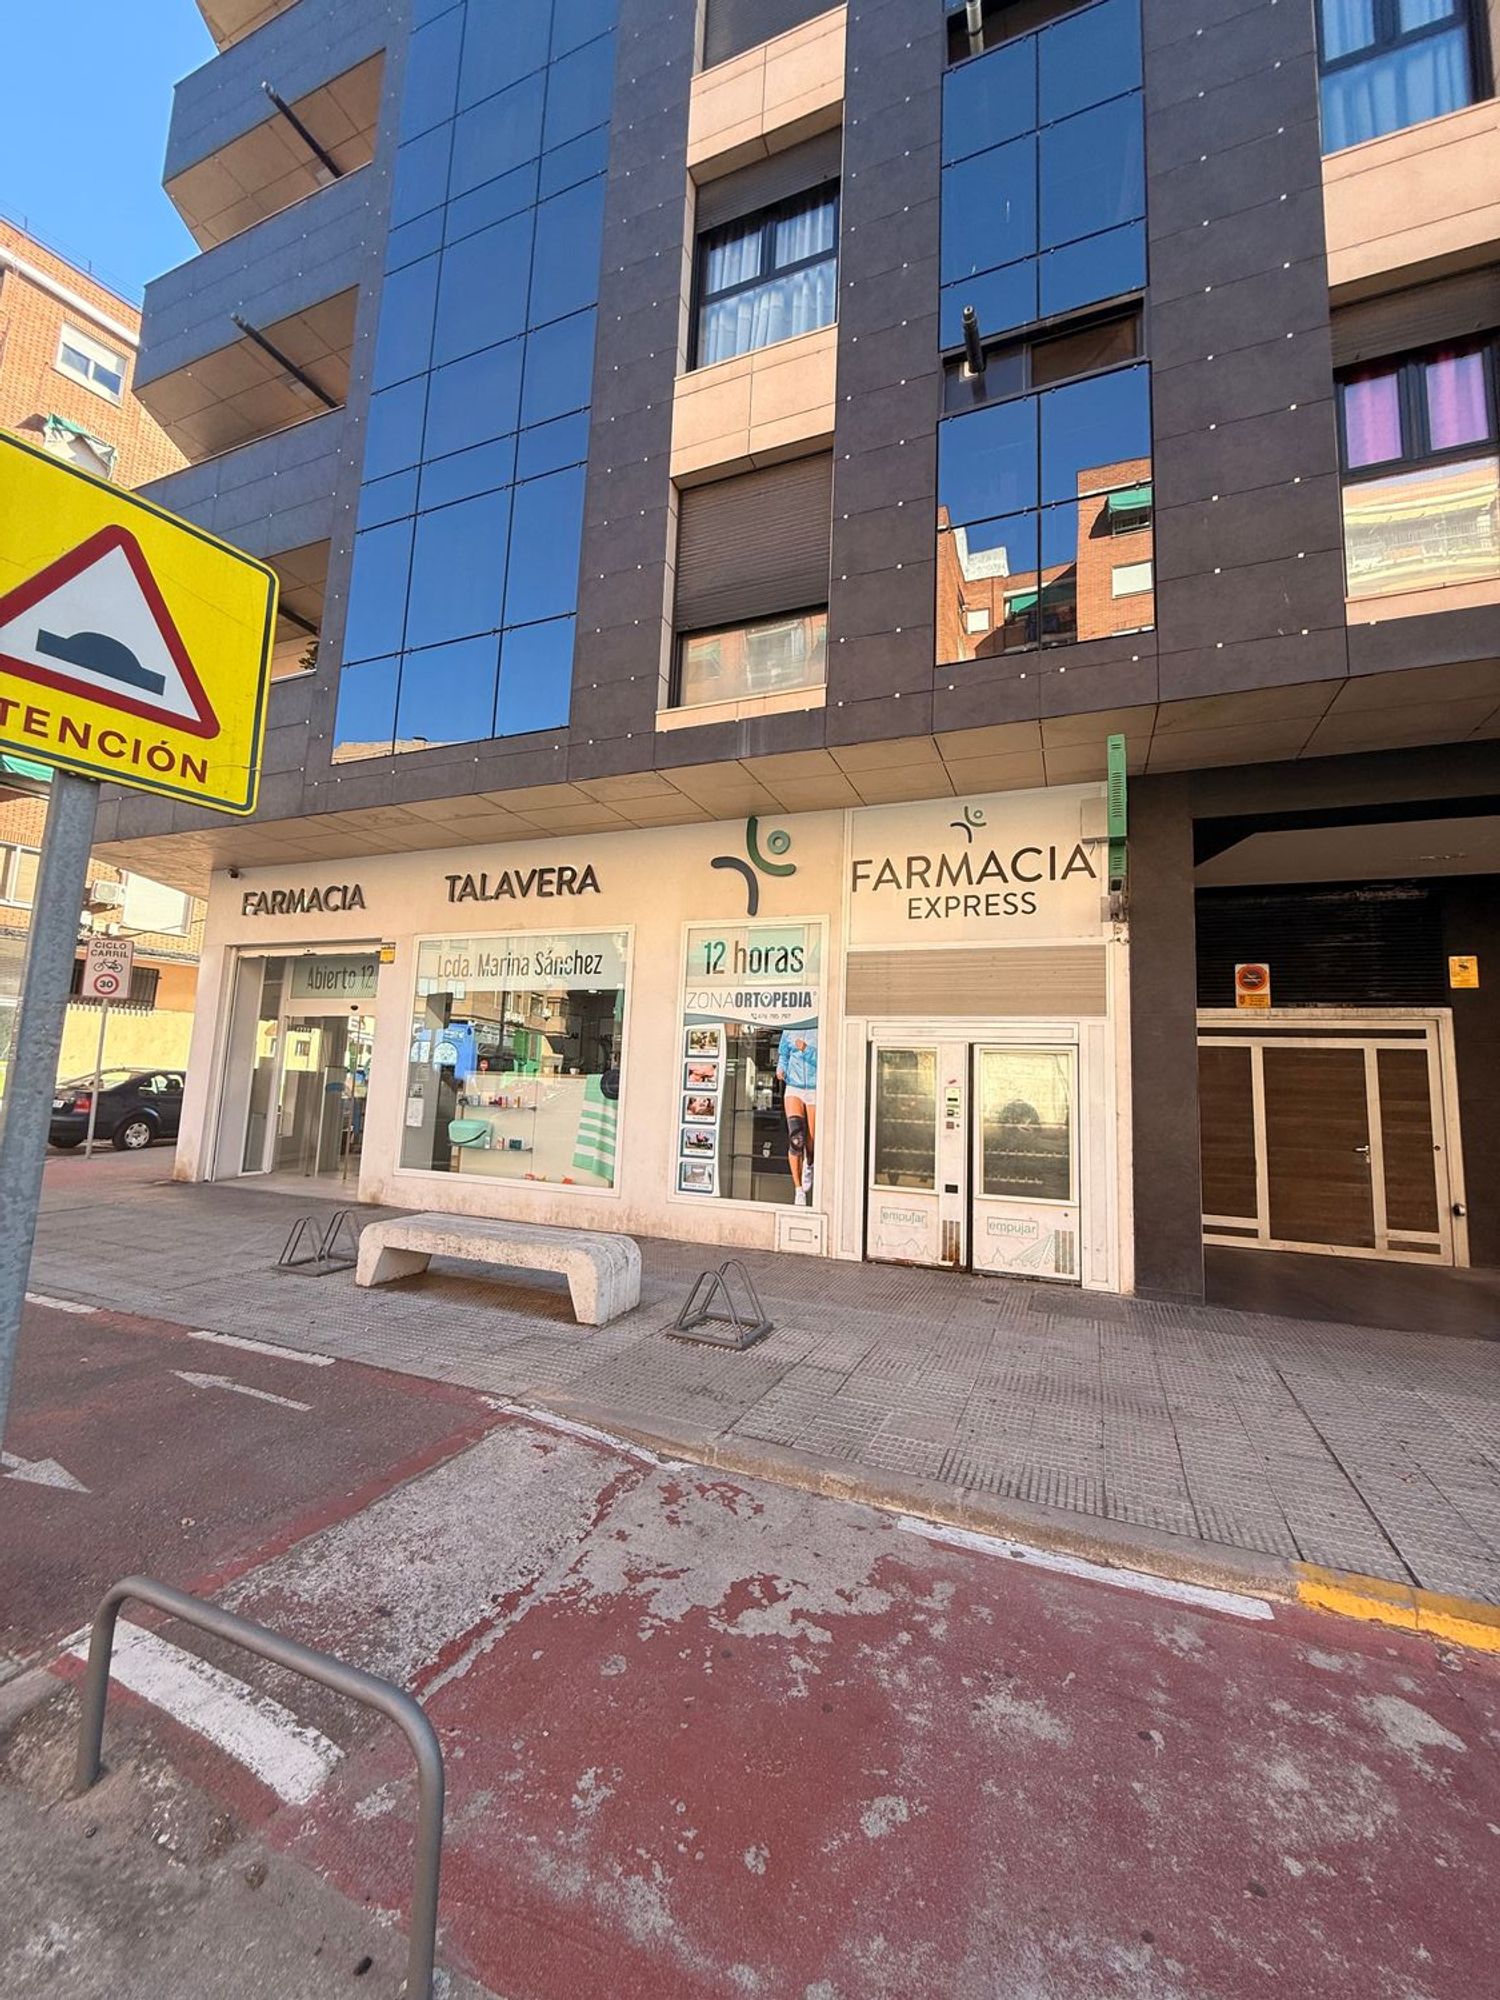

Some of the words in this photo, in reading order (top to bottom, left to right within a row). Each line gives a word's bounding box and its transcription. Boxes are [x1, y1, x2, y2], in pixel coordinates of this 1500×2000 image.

[0, 697, 208, 784] TENCIÓN
[852, 843, 1098, 892] FARMACIA
[444, 864, 601, 903] TALAVERA
[241, 883, 367, 916] FARMACIA
[907, 891, 1037, 919] EXPRESS
[91, 949, 129, 958] CARRIL
[94, 941, 127, 950] CICLO
[703, 941, 726, 975] 12
[733, 940, 805, 975] horas
[306, 964, 356, 990] Abierto
[361, 964, 375, 989] 12
[437, 953, 473, 978] Lcda.
[477, 952, 530, 977] Marina
[534, 950, 603, 976] Sánchez
[99, 980, 114, 988] 30
[882, 1210, 926, 1224] empujar
[988, 1221, 1037, 1236] empujar
